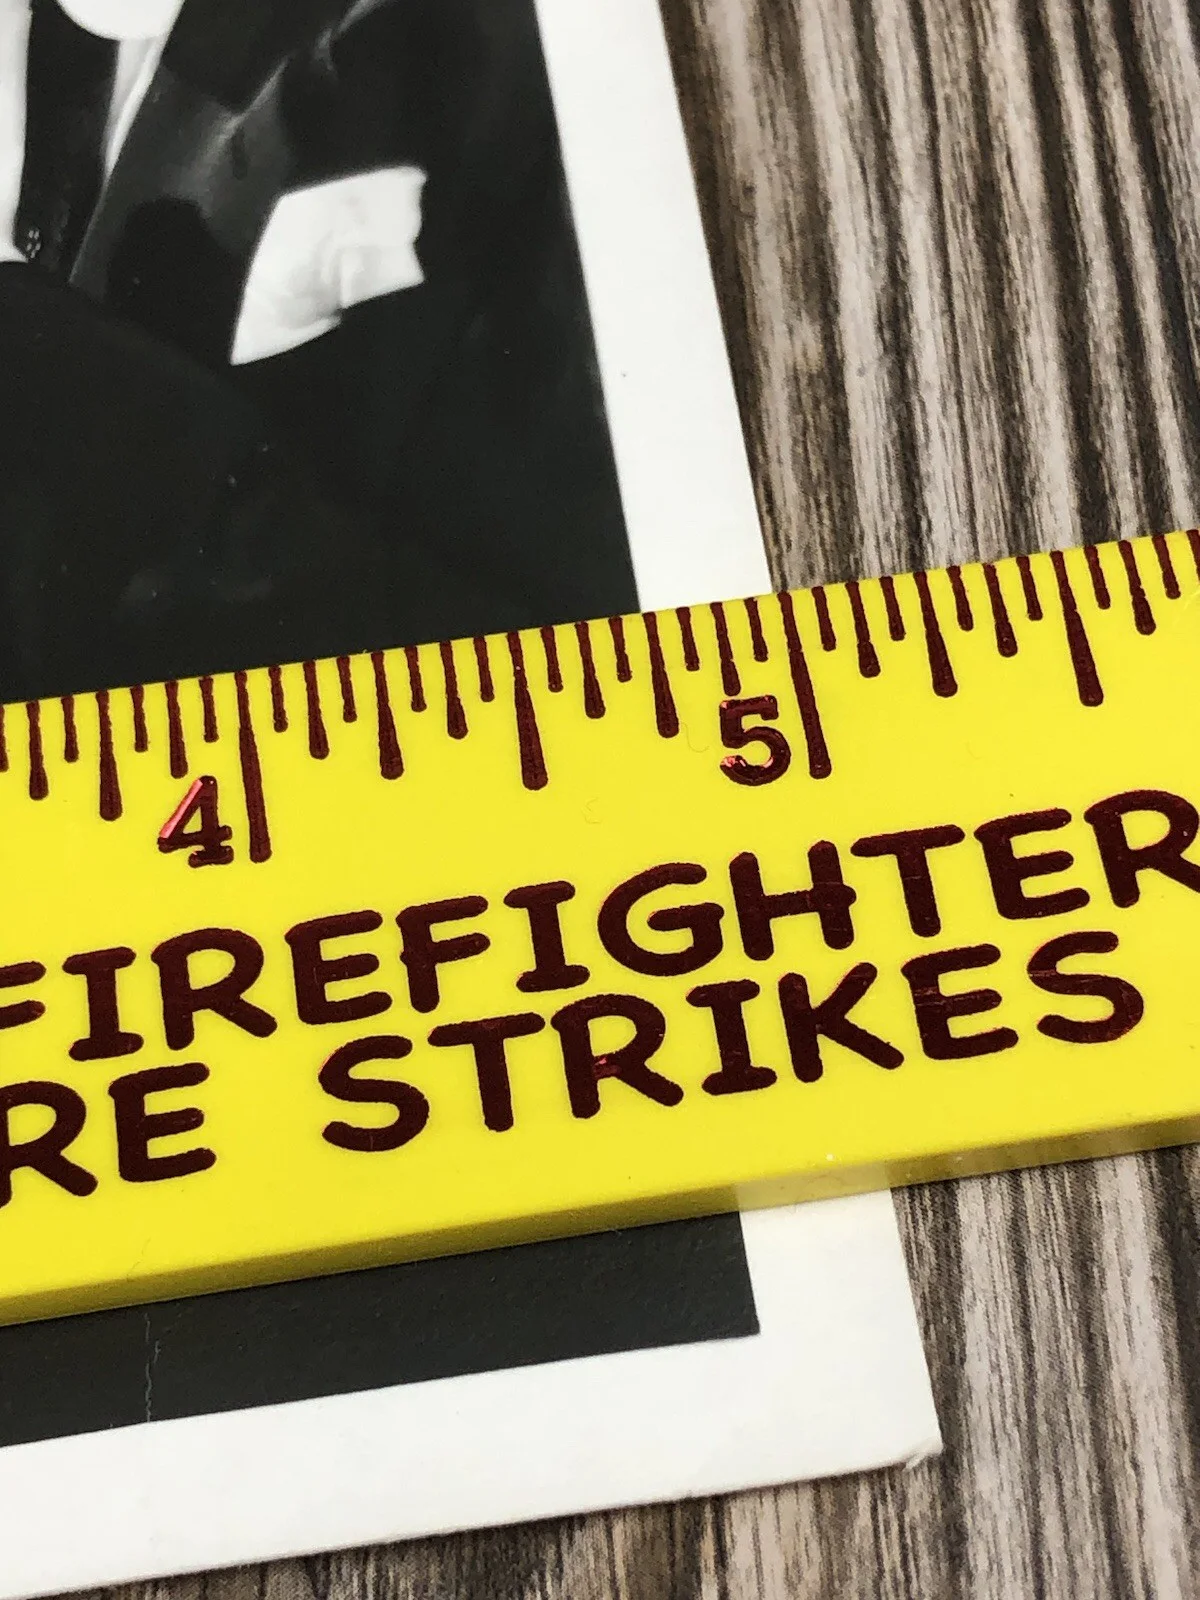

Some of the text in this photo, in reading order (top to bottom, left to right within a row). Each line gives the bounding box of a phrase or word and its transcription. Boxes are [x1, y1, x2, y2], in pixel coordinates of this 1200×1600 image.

[156, 695, 792, 869] 4 5
[317, 930, 1145, 1153] STRIKES
